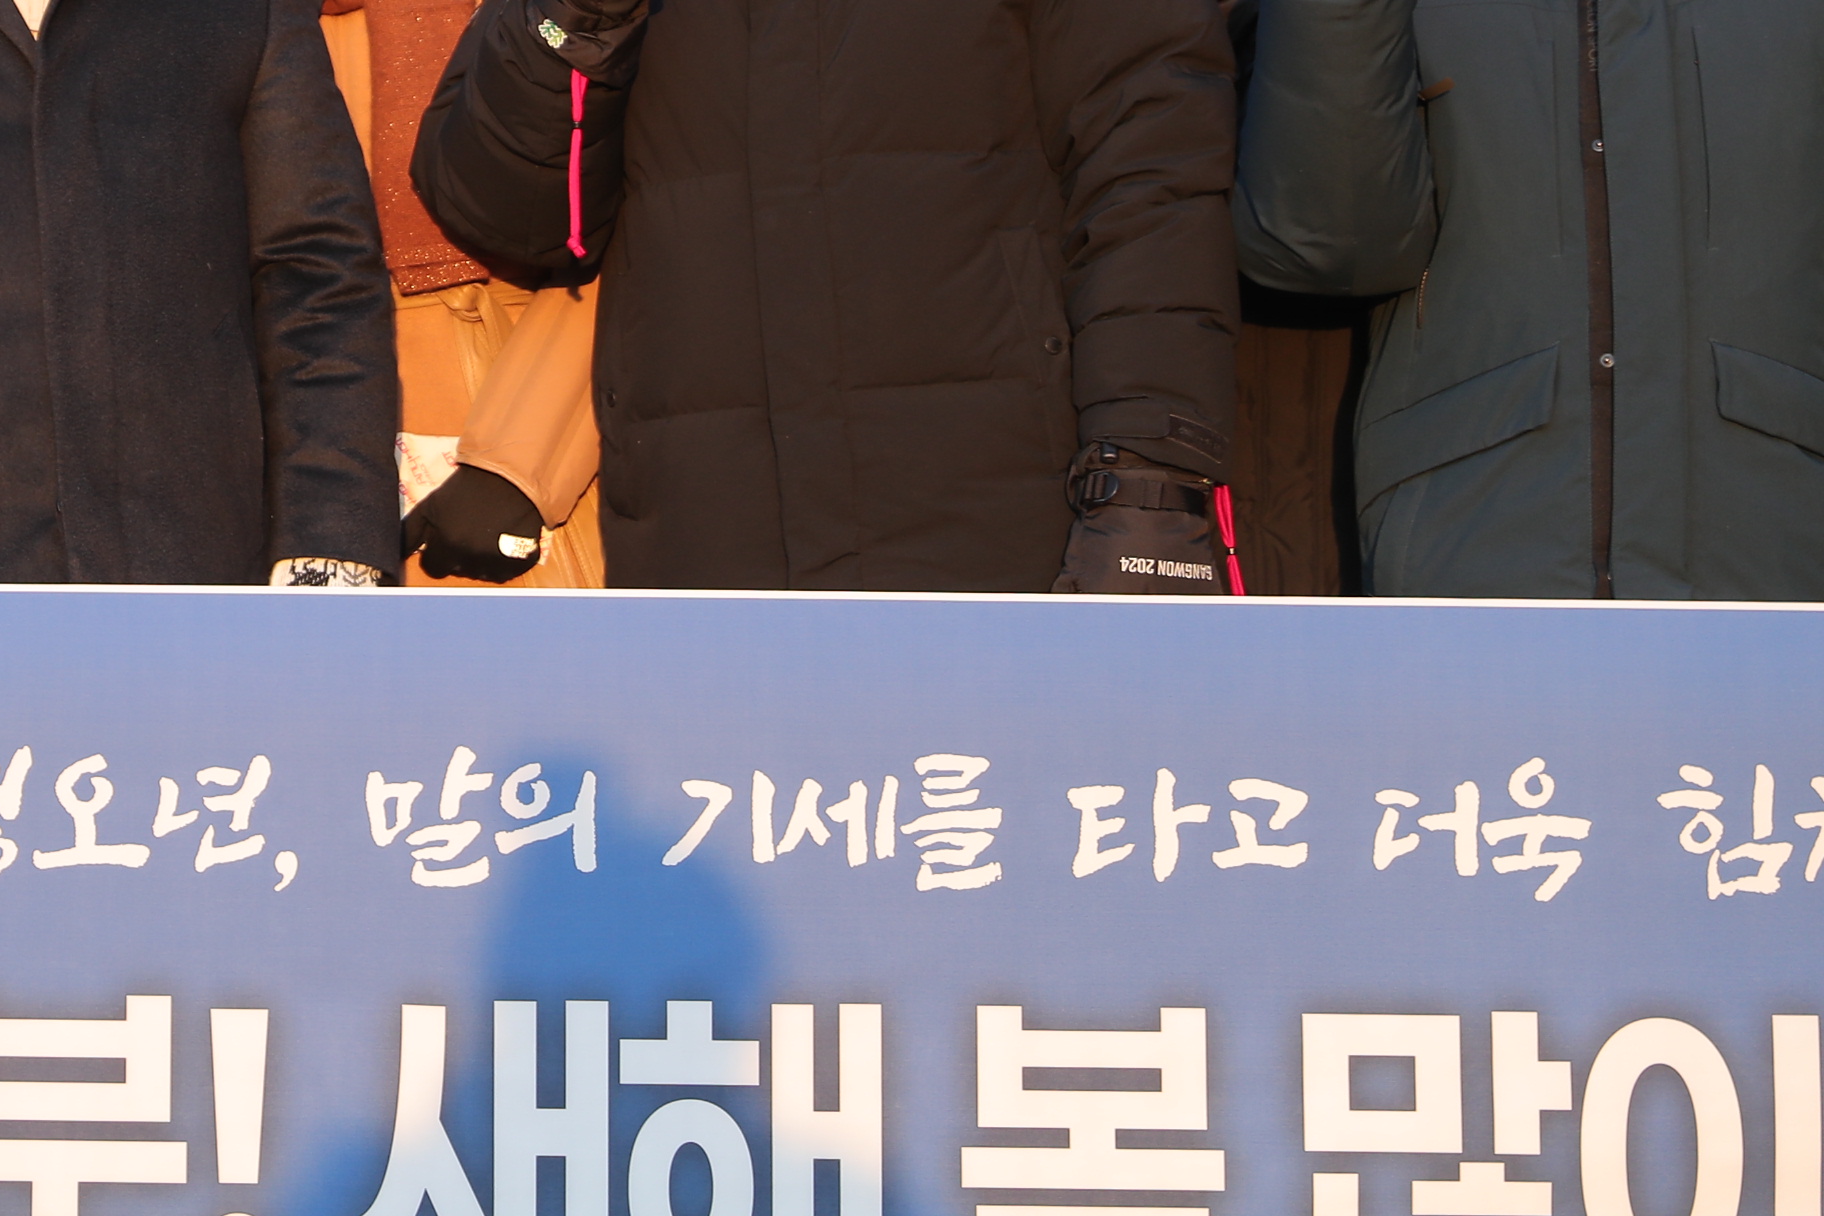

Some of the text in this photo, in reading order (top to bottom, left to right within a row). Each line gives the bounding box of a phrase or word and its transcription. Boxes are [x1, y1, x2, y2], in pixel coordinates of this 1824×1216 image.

[1119, 556, 1213, 581] GANGWON 2024
[365, 745, 597, 888] 말의
[662, 753, 1003, 892] 기세를
[1067, 767, 1309, 883] 타고
[1372, 757, 1592, 902] 더욱
[362, 1000, 882, 1216] 새해
